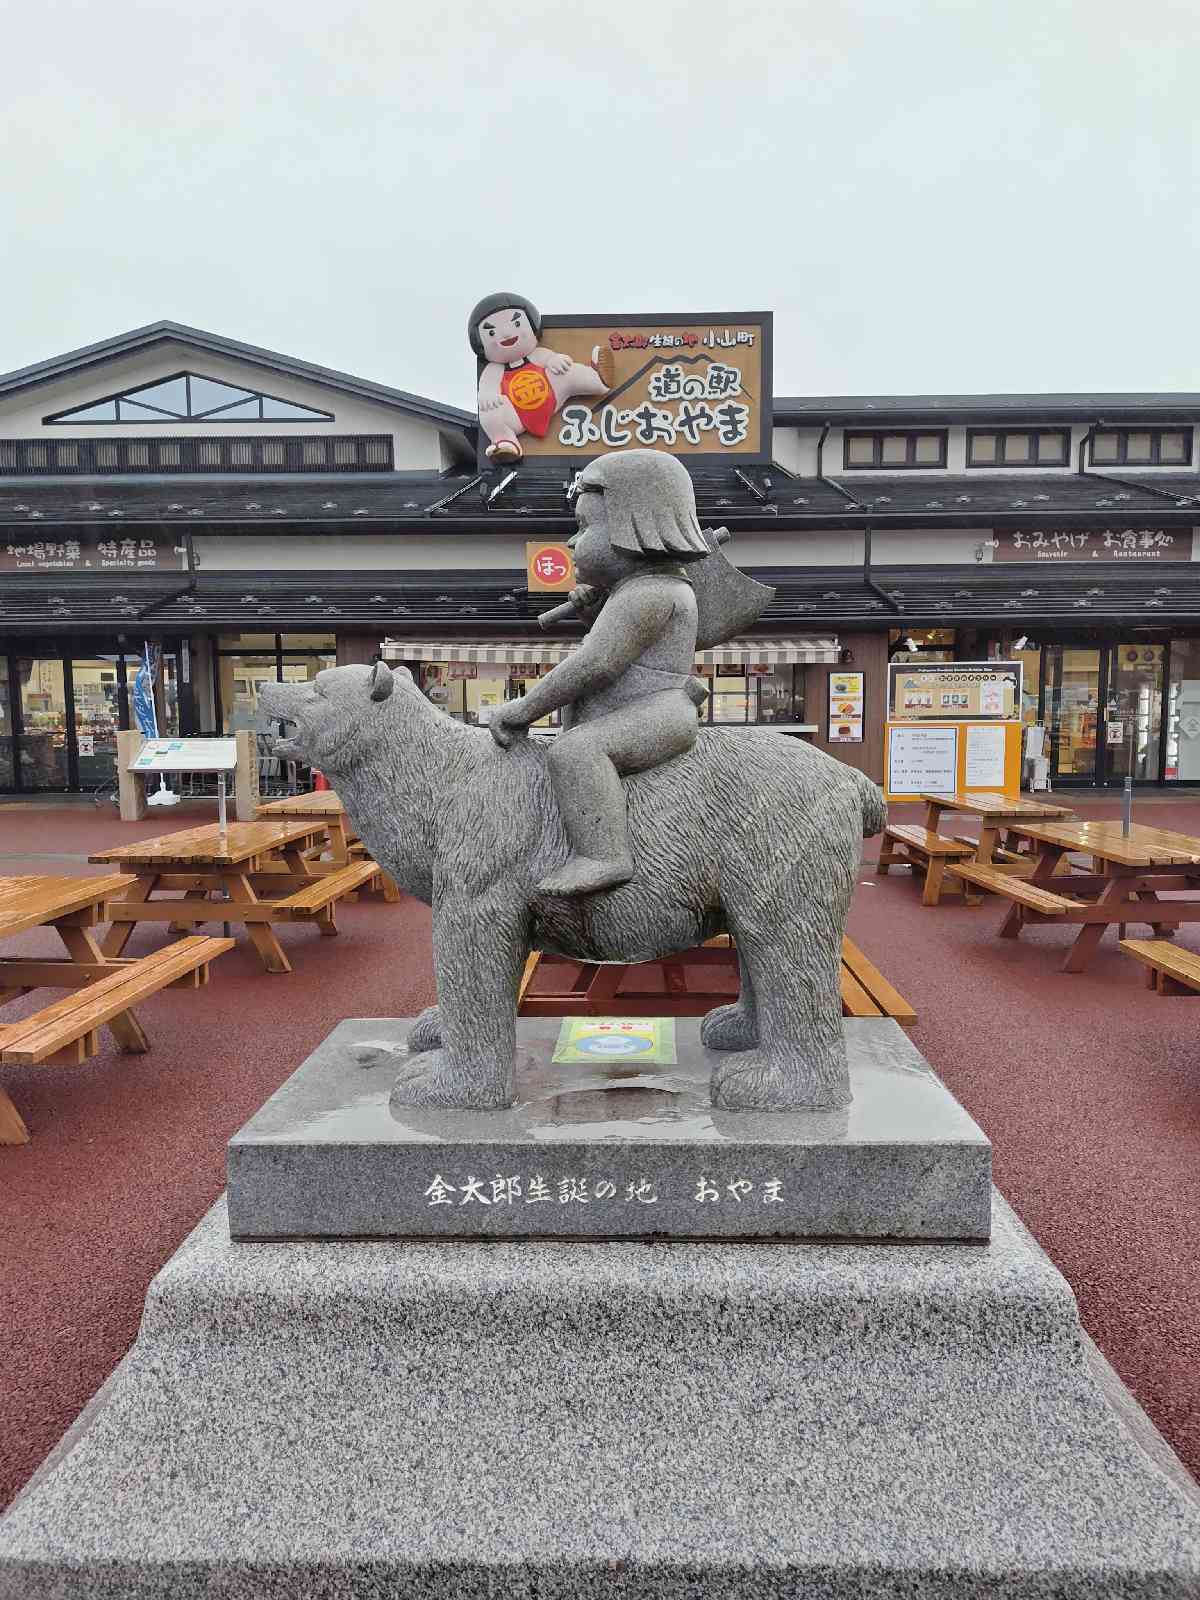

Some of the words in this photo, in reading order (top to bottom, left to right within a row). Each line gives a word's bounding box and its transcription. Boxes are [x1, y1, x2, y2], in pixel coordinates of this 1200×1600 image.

[703, 328, 755, 348] 小山町
[650, 363, 741, 400] 道の駅
[559, 401, 748, 446] ふじおやま
[7, 540, 81, 560] 地場野菜
[97, 538, 157, 559] 特産品
[1013, 531, 1089, 549] おみやげ
[1103, 529, 1175, 548] お食事処
[536, 556, 567, 576] ほっ
[424, 1174, 657, 1206] 金太郎生誕の地
[695, 1177, 784, 1204] おやま
